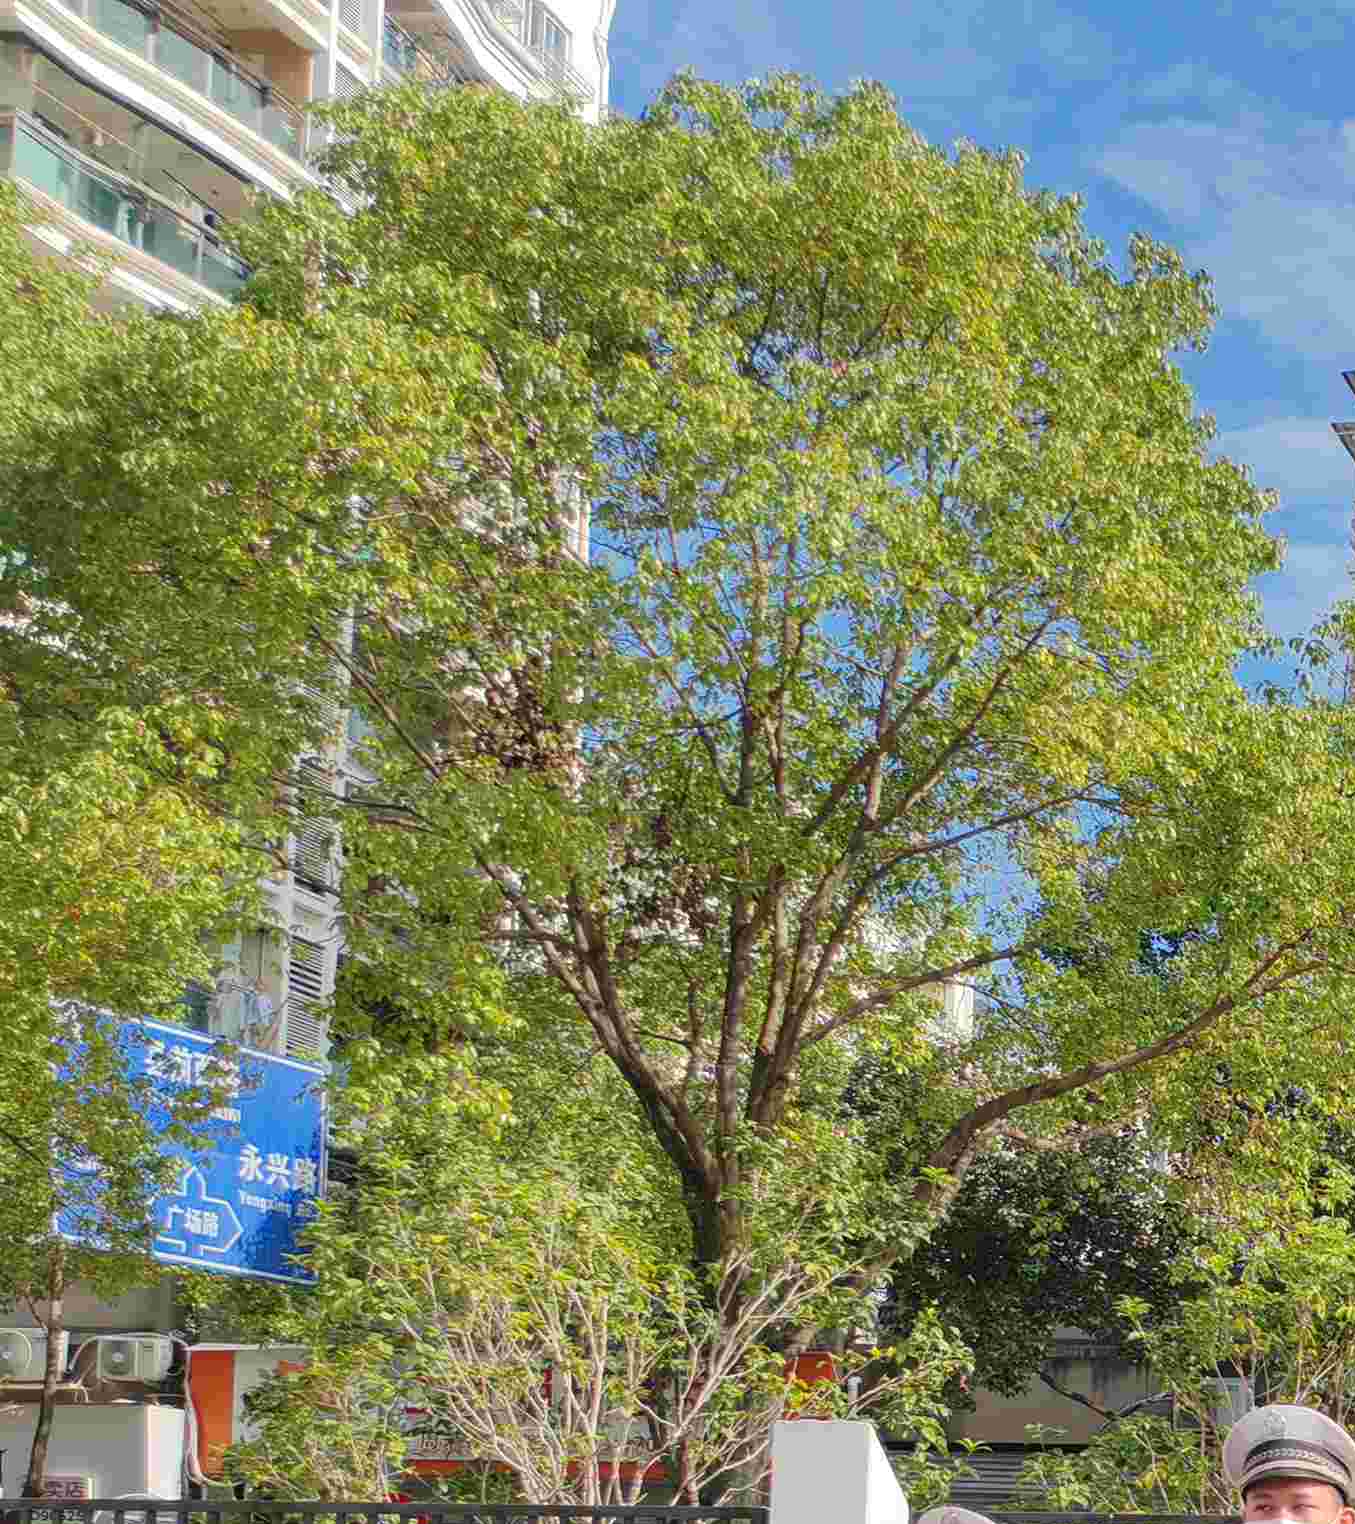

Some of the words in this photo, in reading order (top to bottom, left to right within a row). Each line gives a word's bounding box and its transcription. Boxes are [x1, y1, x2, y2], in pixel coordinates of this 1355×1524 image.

[239, 1143, 318, 1194] 永兴路
[167, 1205, 220, 1237] 广场路
